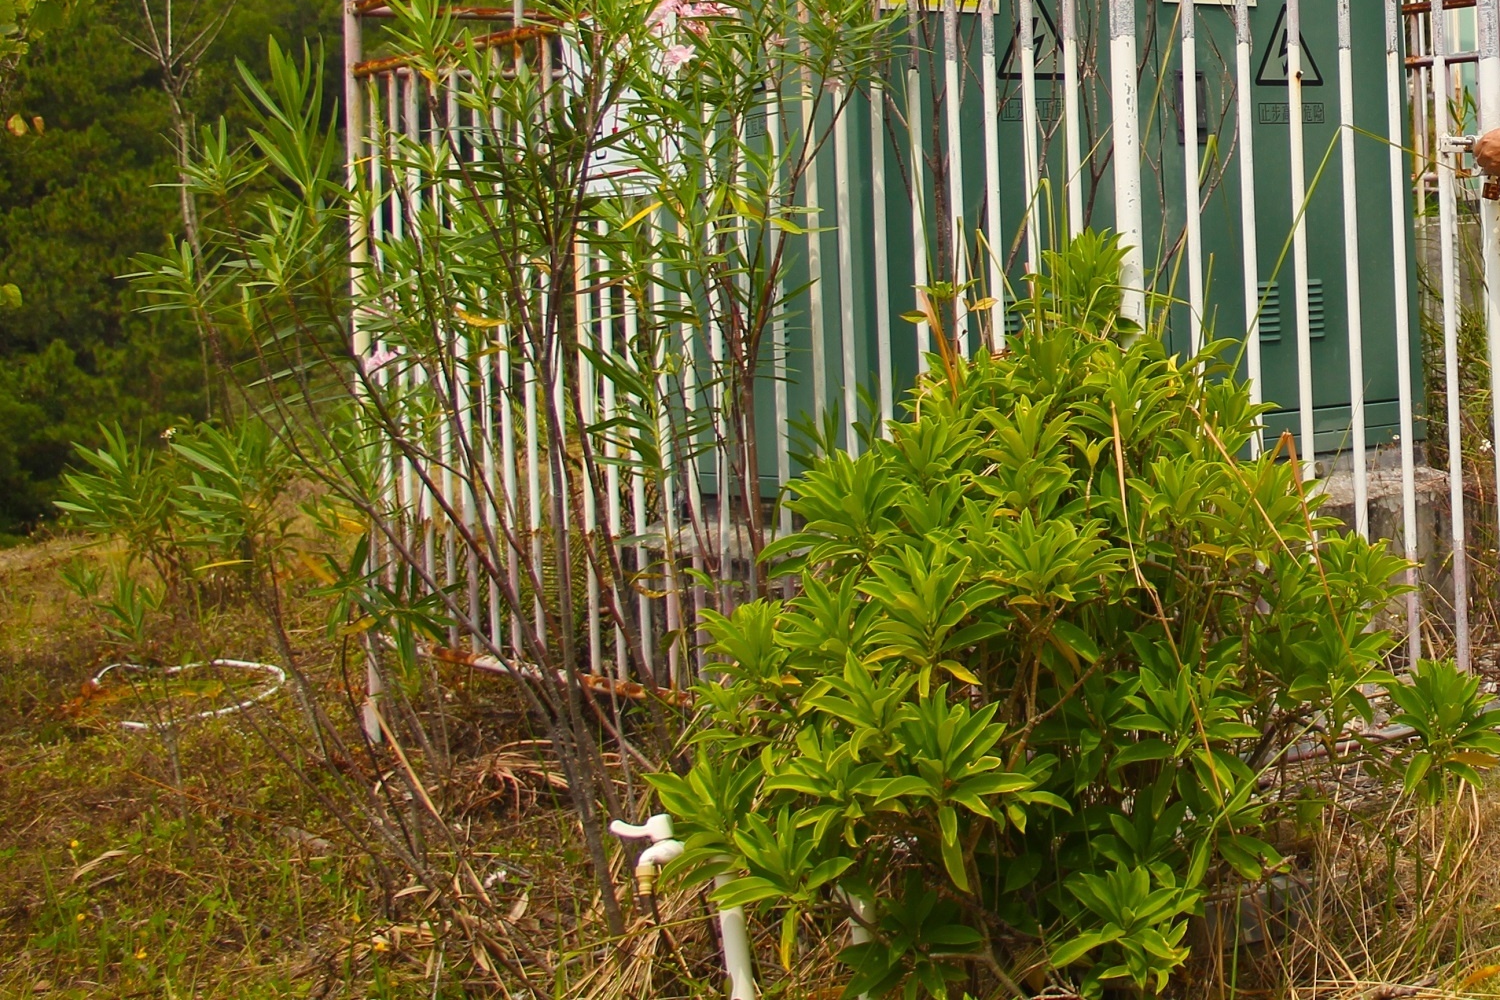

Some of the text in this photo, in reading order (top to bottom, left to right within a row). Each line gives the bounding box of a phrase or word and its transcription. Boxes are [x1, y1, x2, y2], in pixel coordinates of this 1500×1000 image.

[1262, 103, 1323, 122] 止步高危险
